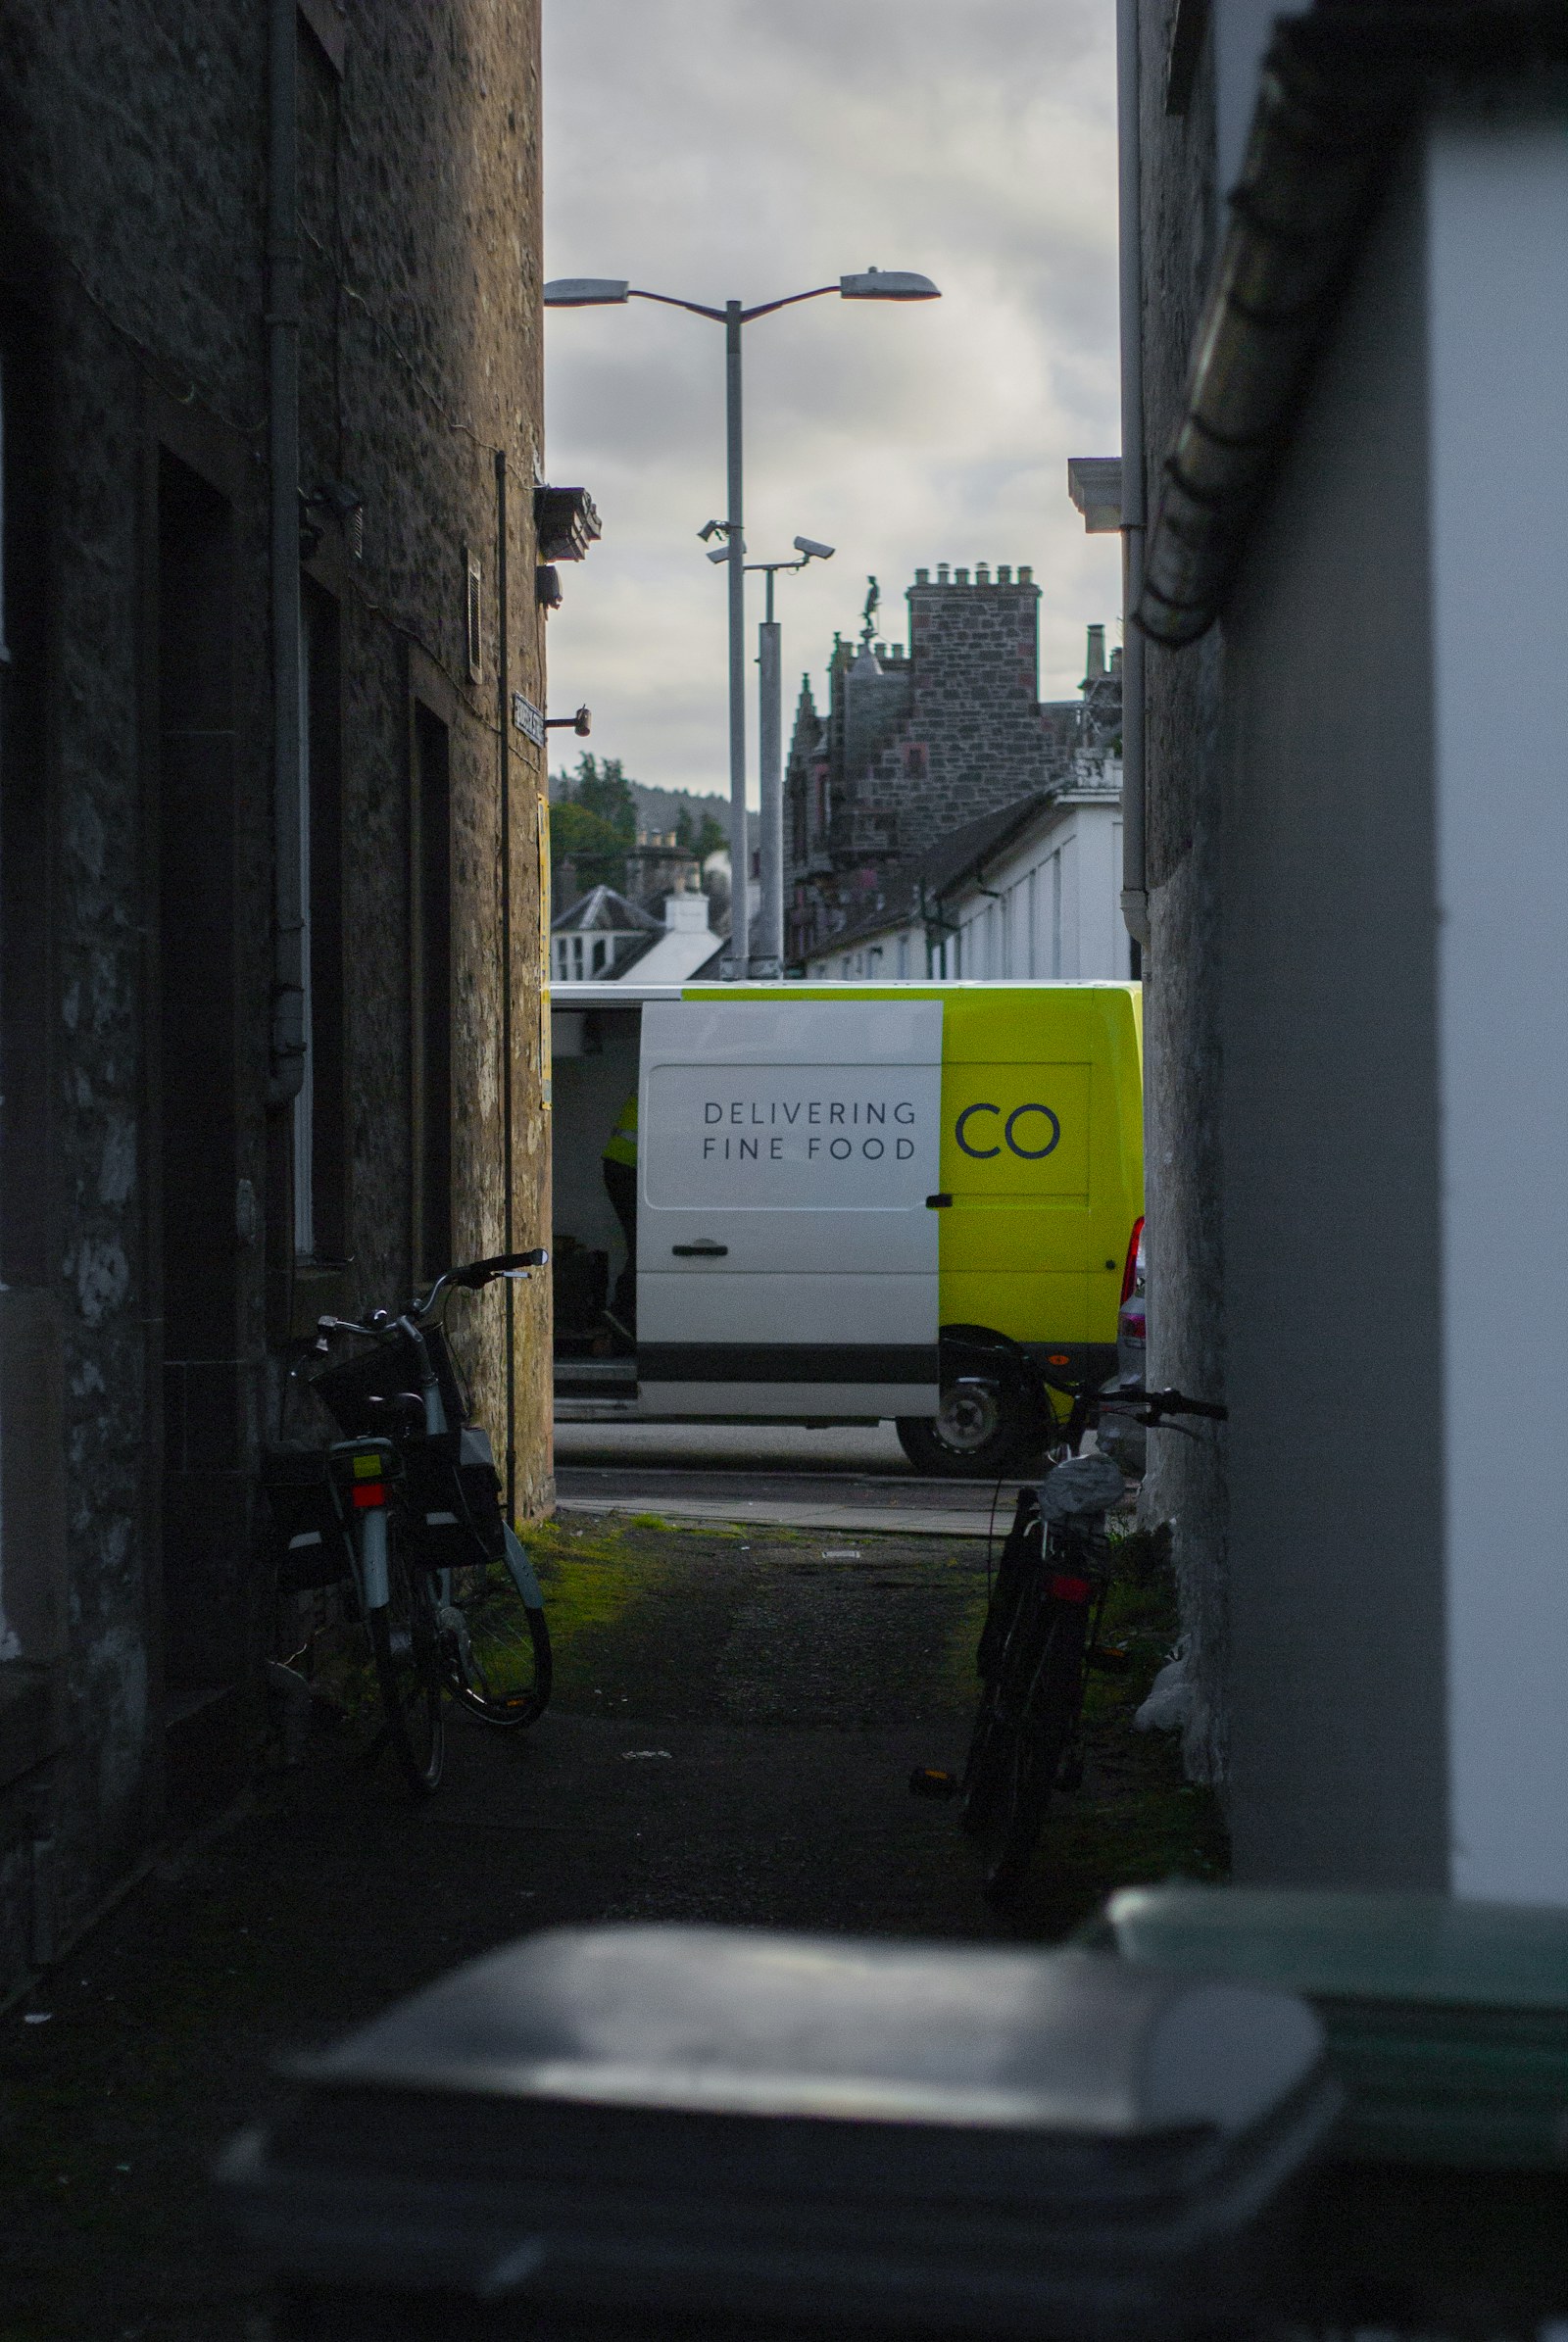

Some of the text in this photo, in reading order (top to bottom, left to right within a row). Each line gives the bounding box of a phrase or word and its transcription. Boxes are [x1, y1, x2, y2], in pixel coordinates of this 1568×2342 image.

[705, 1102, 915, 1125] DELIVERING
[955, 1102, 1061, 1160] CO
[703, 1138, 915, 1160] FINE FOOD
